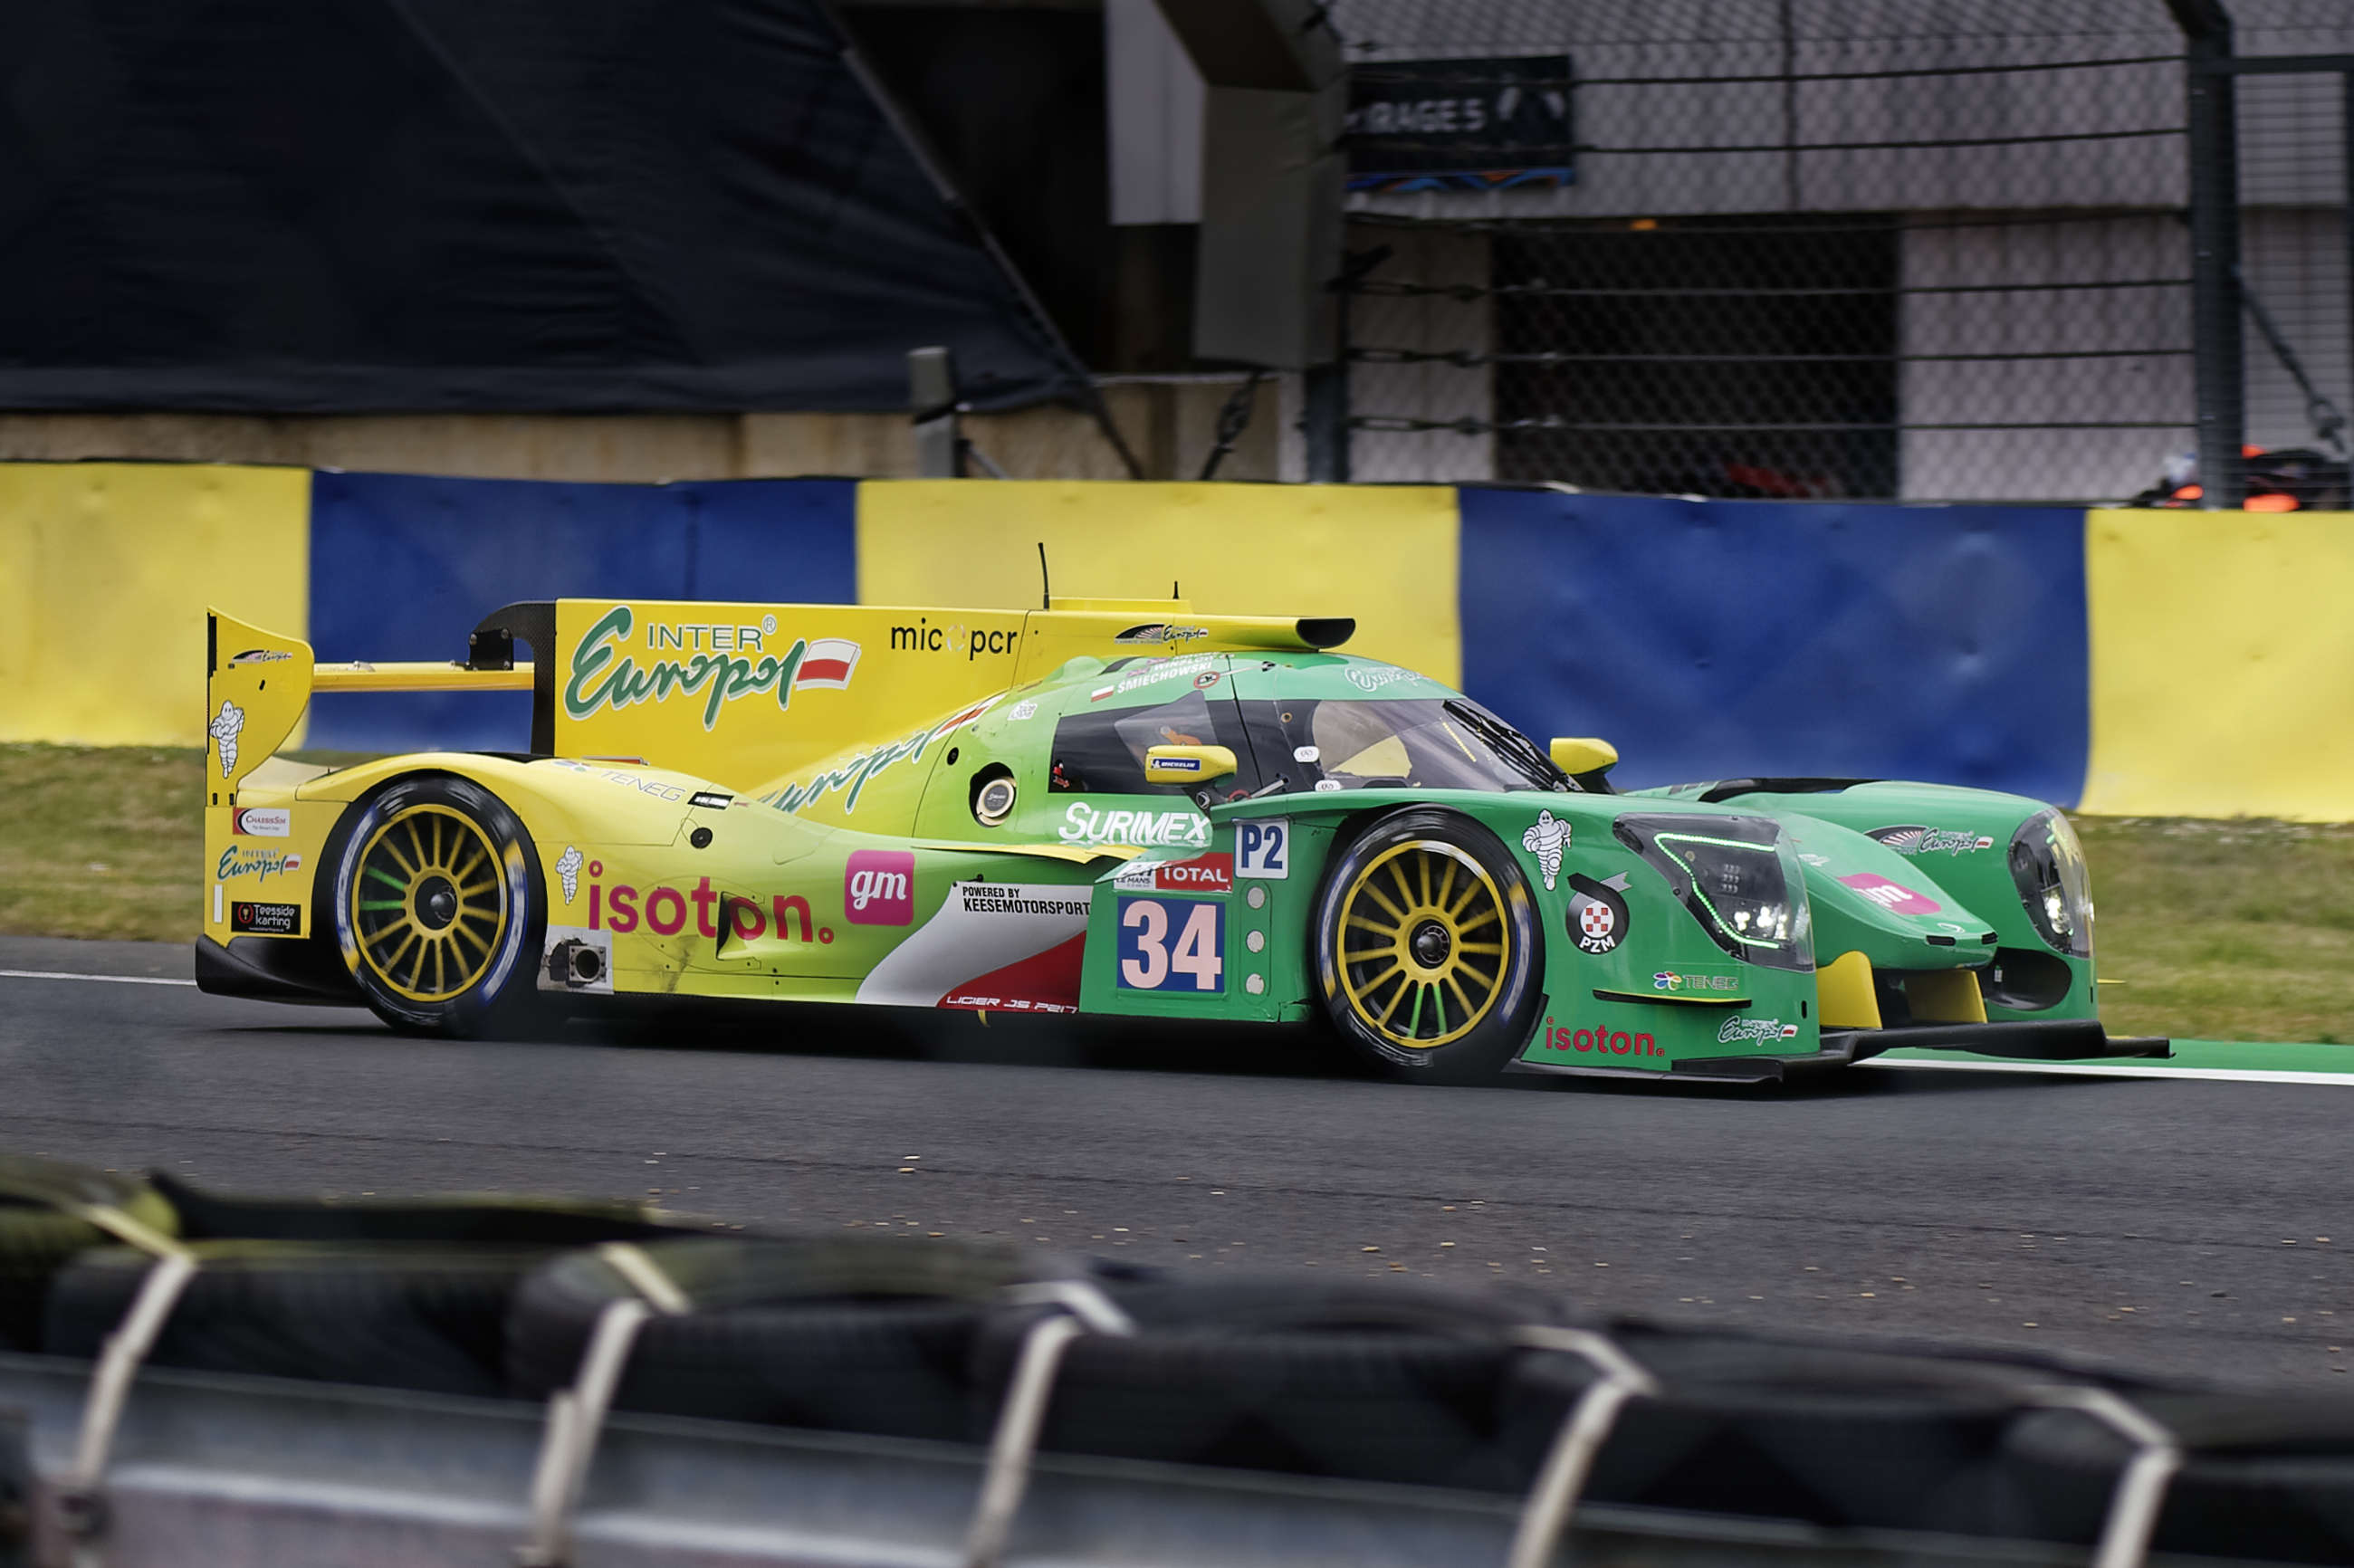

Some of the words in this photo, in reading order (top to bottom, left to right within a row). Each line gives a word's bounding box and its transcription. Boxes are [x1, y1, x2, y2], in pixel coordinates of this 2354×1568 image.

[564, 605, 808, 731] Europol
[601, 770, 686, 802] TENEG
[1057, 801, 1211, 843] SURIMEX
[217, 845, 288, 883] Europol
[1240, 825, 1286, 871] P2
[851, 870, 906, 911] gm
[962, 886, 1006, 898] POWERED
[1008, 887, 1020, 899] BY
[254, 904, 296, 917] Teesside
[255, 914, 291, 930] karting
[1121, 899, 1223, 991] 34
[1578, 934, 1616, 953] PZM
[946, 995, 1000, 1007] LIGIER
[1003, 999, 1031, 1009] JS
[1034, 1001, 1078, 1014] P217
